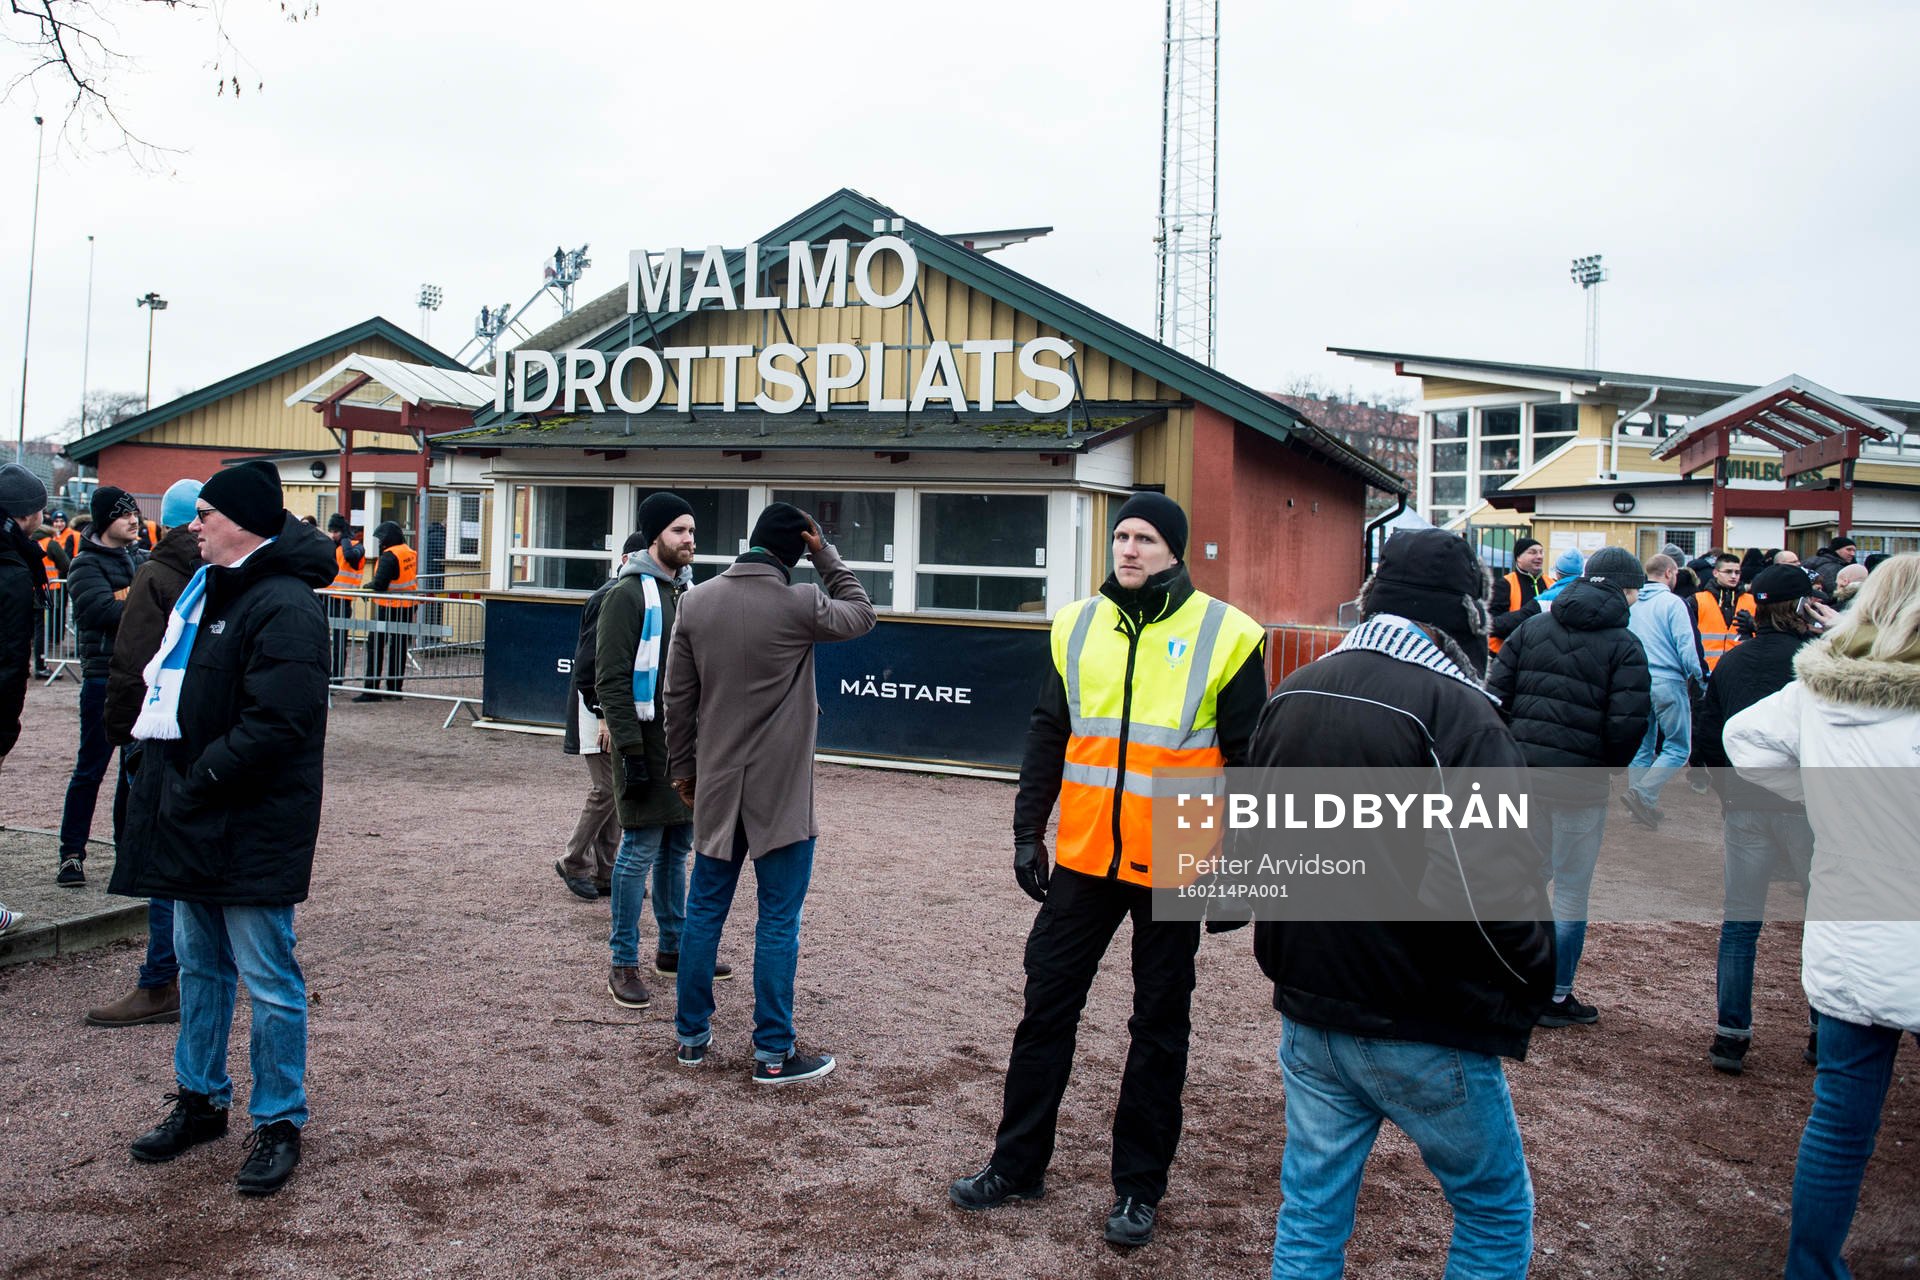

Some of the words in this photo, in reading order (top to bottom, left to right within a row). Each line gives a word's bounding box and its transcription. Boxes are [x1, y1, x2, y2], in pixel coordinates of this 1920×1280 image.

[626, 218, 919, 314] MALMÖ
[493, 336, 1078, 414] IDROTTSPLATS
[840, 674, 972, 704] MÄSTARE
